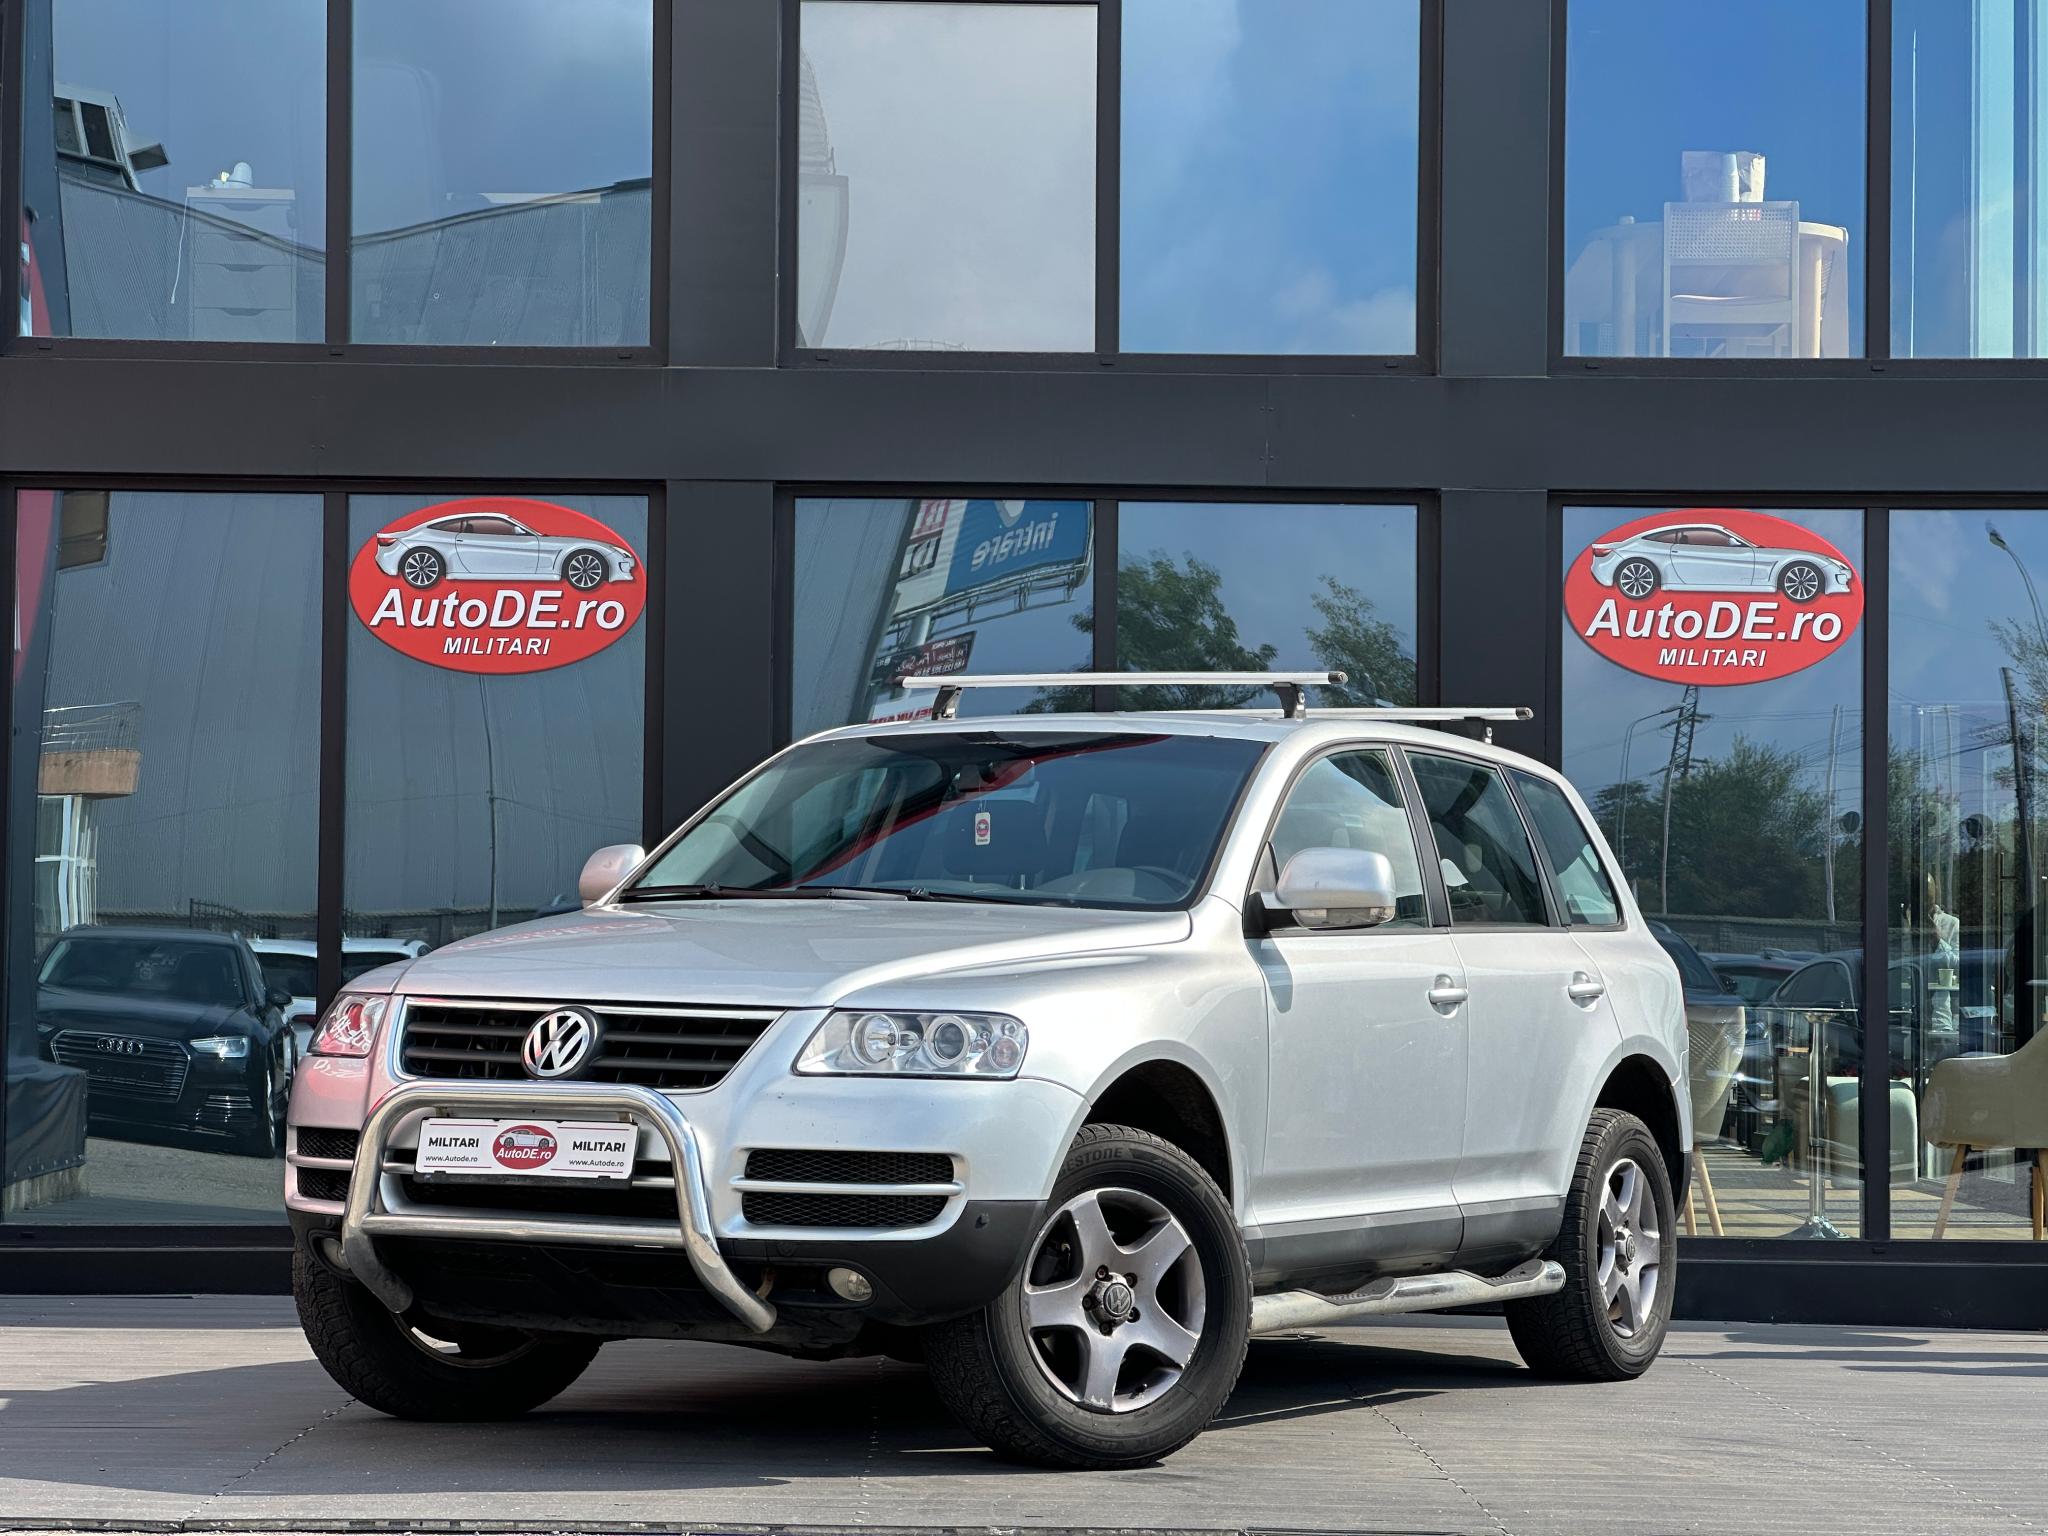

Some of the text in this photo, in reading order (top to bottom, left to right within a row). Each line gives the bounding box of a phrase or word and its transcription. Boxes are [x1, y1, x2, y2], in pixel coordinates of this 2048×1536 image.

[369, 588, 626, 629] AutoDE.ro
[1585, 599, 1843, 642] AutoDE.ro
[443, 637, 551, 655] MILITARI
[1658, 649, 1767, 667] MILITARI
[428, 1137, 479, 1148] MILITARI
[572, 1141, 626, 1152] MILITARI
[425, 1155, 478, 1163] www.Autode.ro
[496, 1147, 552, 1160] AutoDE.ro
[569, 1159, 625, 1167] www.Autode.ro
